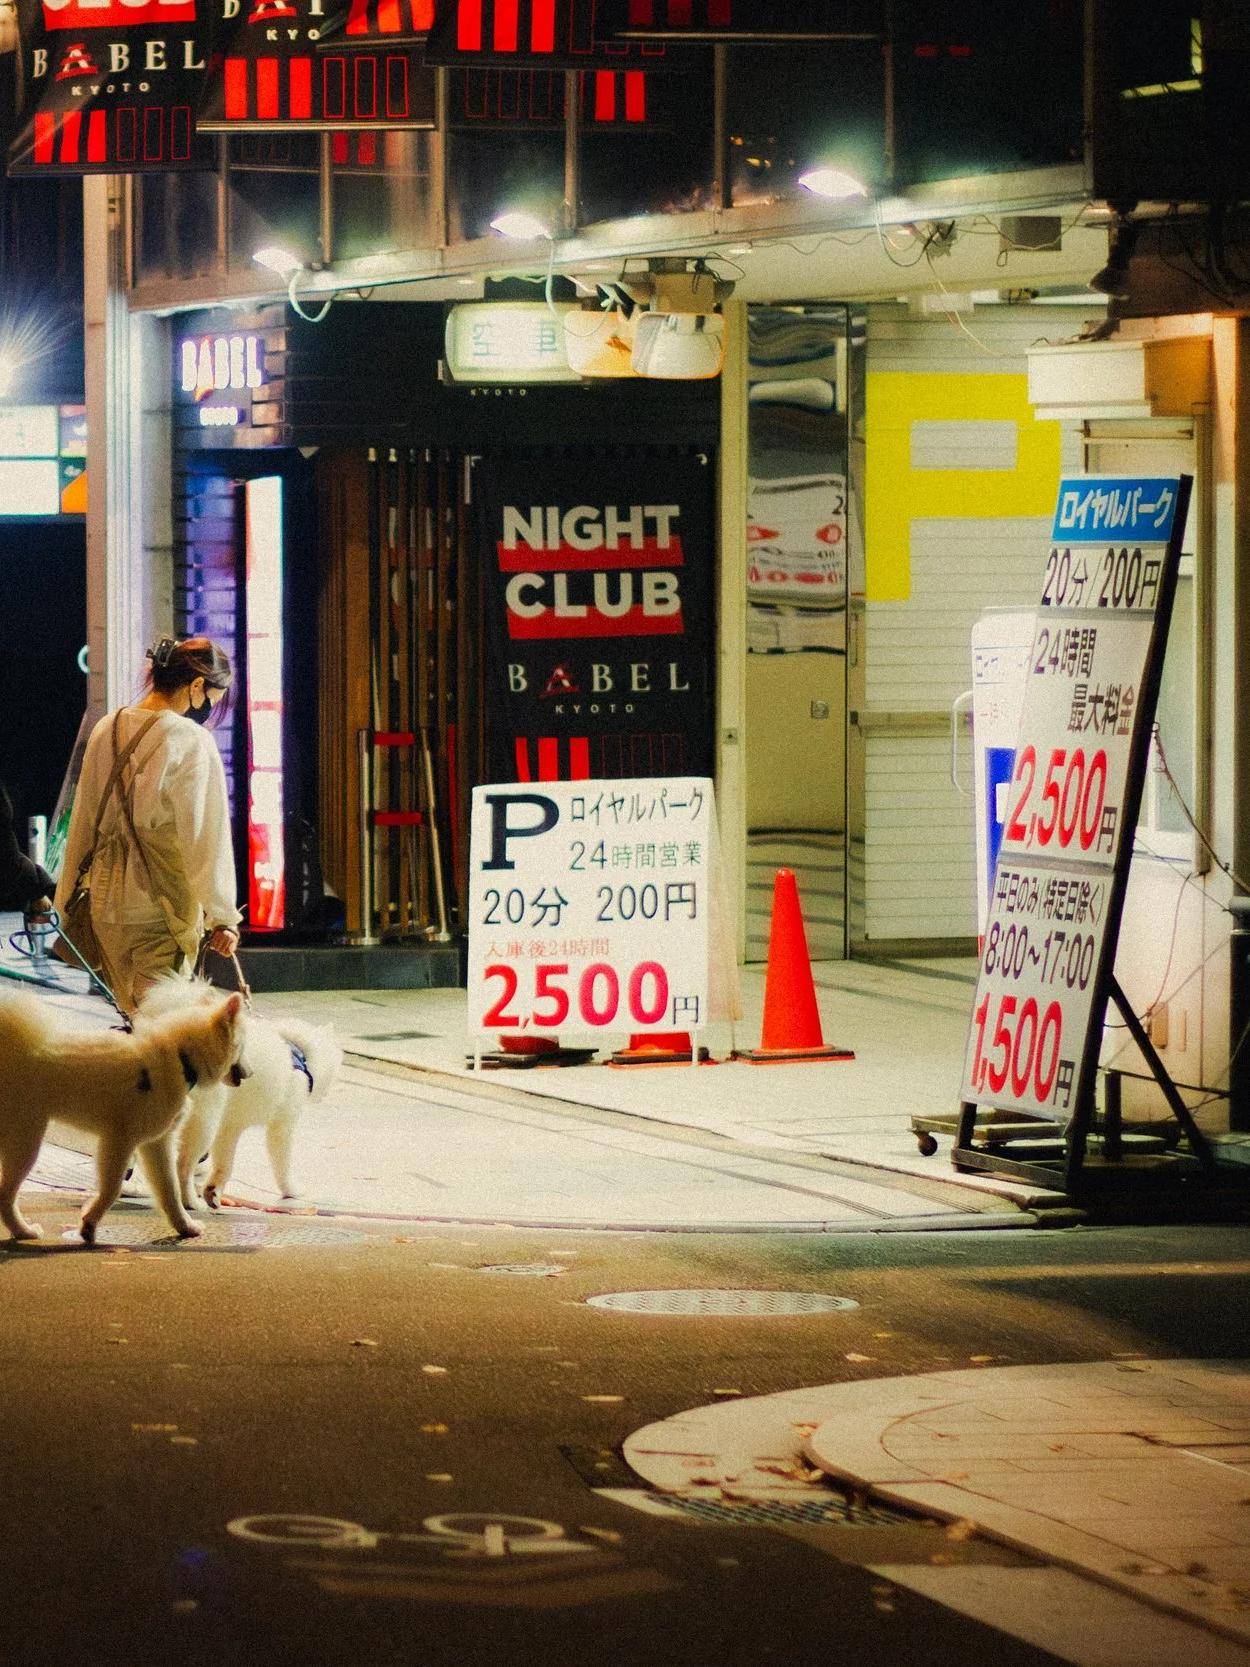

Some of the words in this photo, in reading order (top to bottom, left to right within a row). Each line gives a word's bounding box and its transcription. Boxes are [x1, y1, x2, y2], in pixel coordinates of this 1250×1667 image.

[33, 40, 206, 80] BABEL
[71, 82, 150, 96] KYOTO
[503, 505, 680, 550] NIGHT
[1058, 486, 1174, 529] ロイヤルパーク
[505, 572, 682, 618] CLUB
[1033, 627, 1097, 679] 24時間
[507, 662, 690, 696] BABEL
[555, 703, 634, 715] KYOTO
[1066, 682, 1135, 737] 最大料金
[570, 787, 704, 826] ロイヤルパーク
[1005, 743, 1118, 854] 2,500円
[482, 793, 560, 870] P
[569, 839, 702, 871] 24時間営業
[483, 886, 569, 927] 20分
[596, 881, 697, 922] 200円
[482, 960, 700, 1030] 2,500円
[971, 992, 1075, 1109] 1,500円
